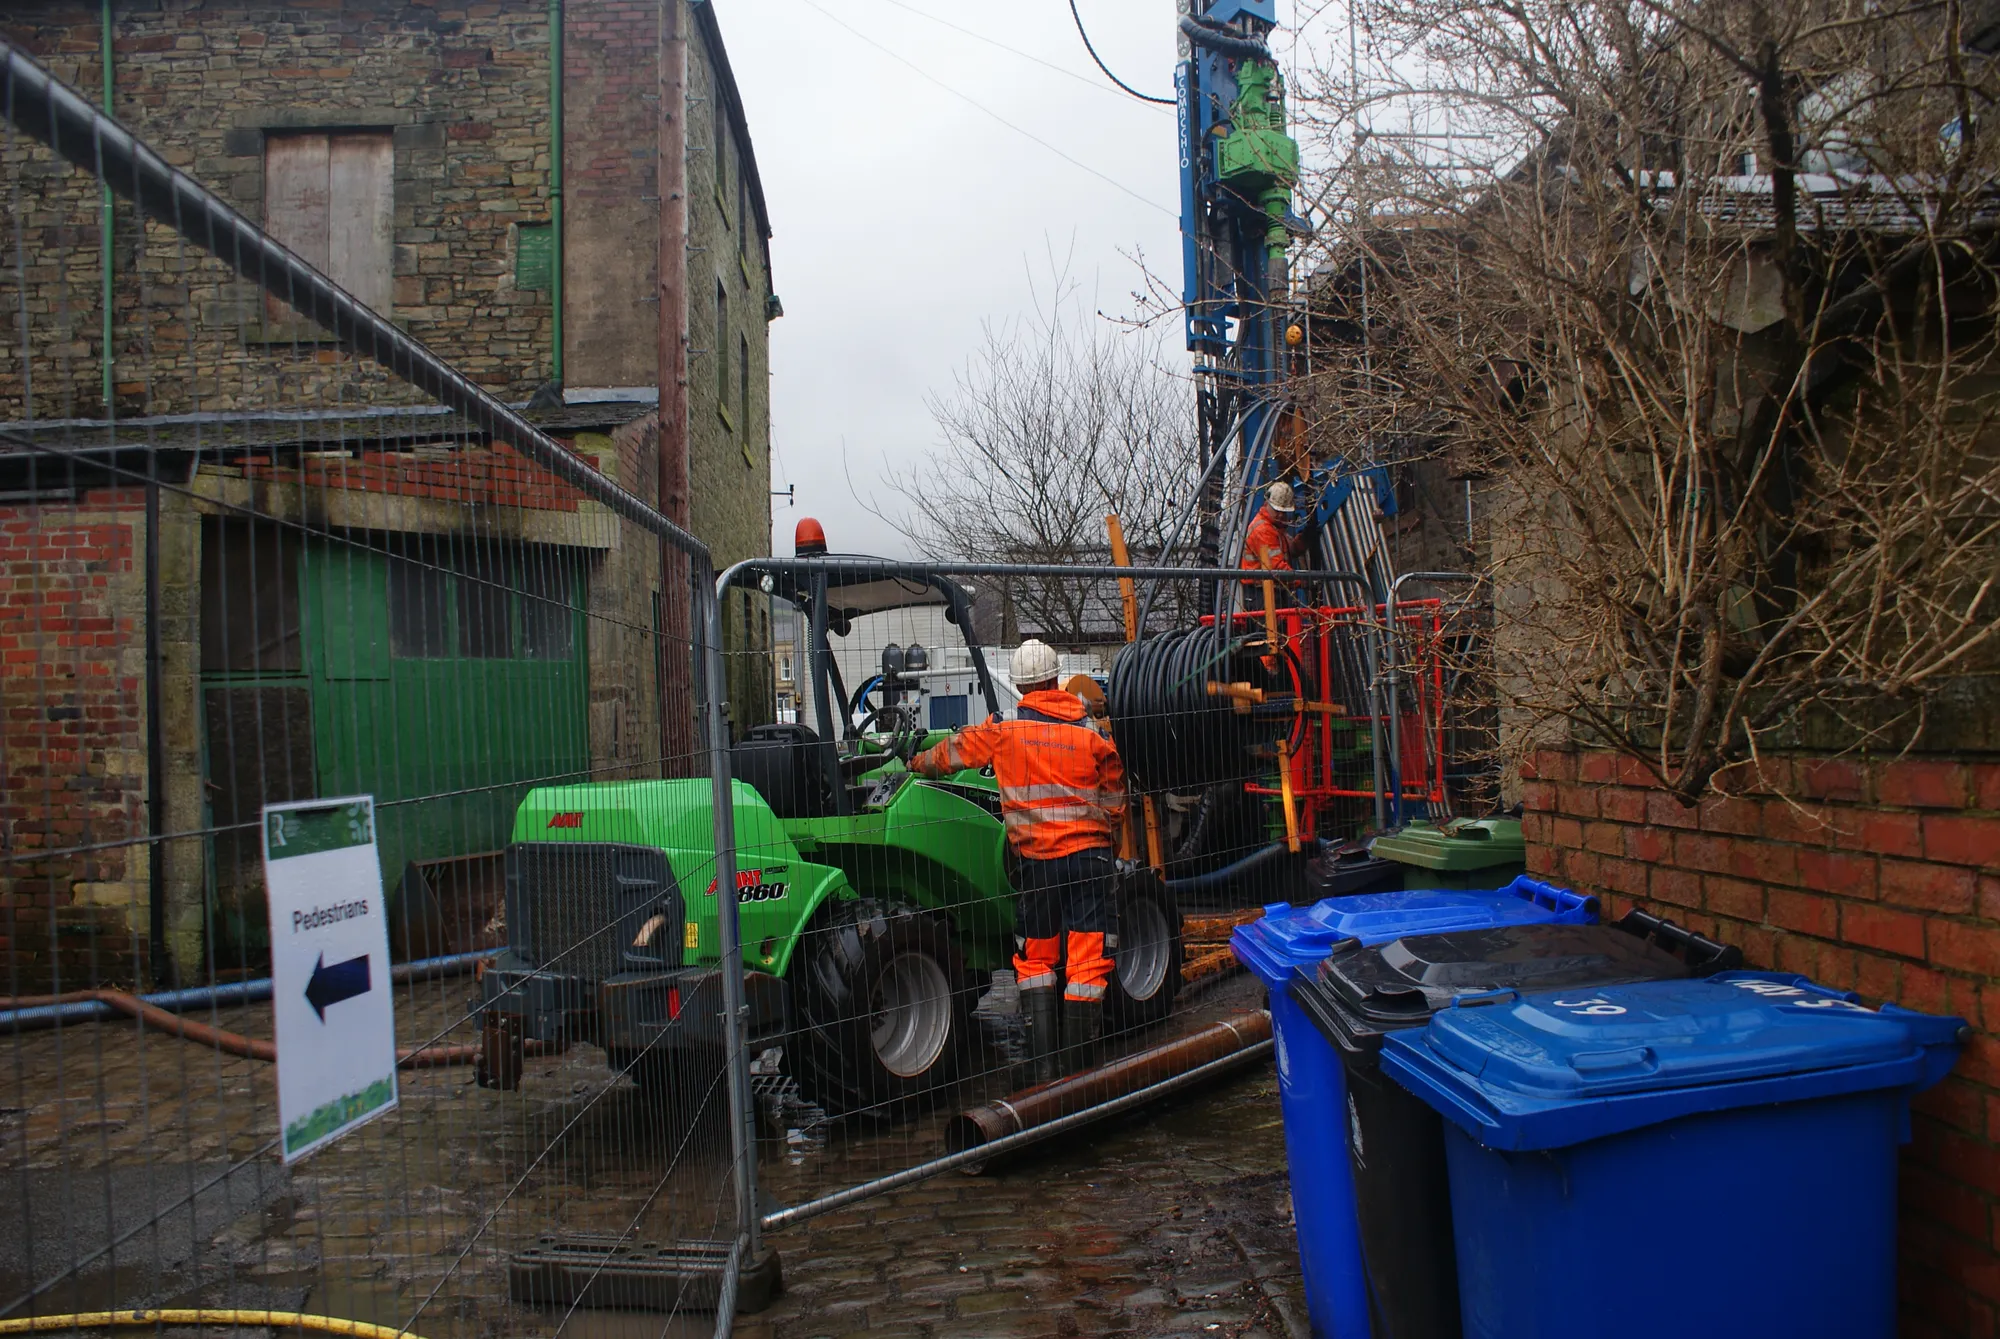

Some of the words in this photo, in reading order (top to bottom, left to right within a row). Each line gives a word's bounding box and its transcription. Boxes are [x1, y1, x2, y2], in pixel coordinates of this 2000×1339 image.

[1178, 77, 1189, 168] COMACCHIO
[1051, 742, 1076, 751] Group
[547, 812, 584, 828] AVANT
[292, 898, 369, 933] Pedestrians
[1553, 998, 1627, 1015] 39
